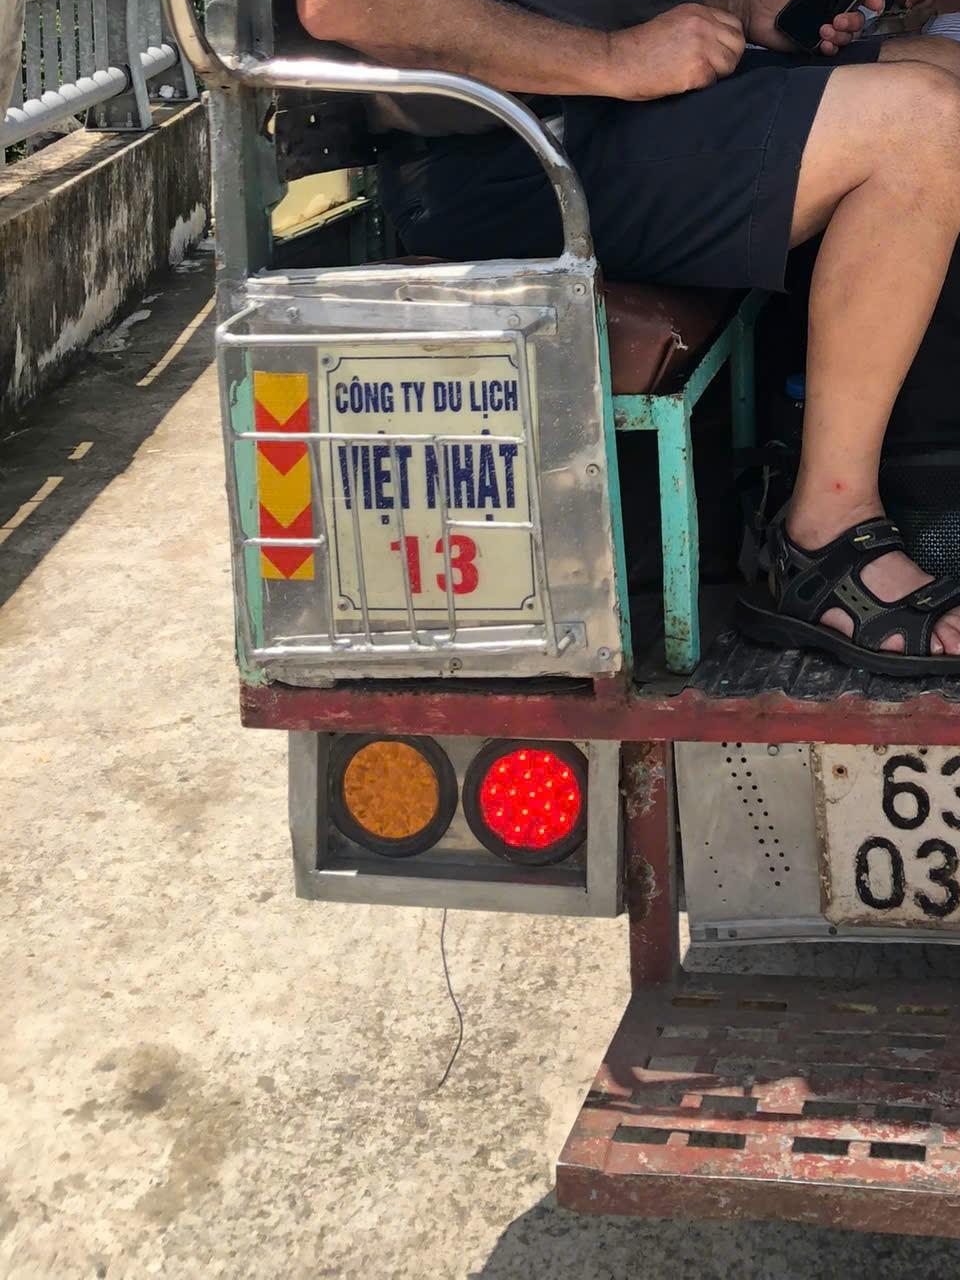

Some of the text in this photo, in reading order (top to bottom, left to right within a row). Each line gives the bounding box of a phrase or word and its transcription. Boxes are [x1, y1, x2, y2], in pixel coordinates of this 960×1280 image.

[335, 375, 519, 419] CÔNG TY DU LỊCH
[337, 429, 519, 525] VIỆT NHẬT
[390, 534, 479, 595] 13
